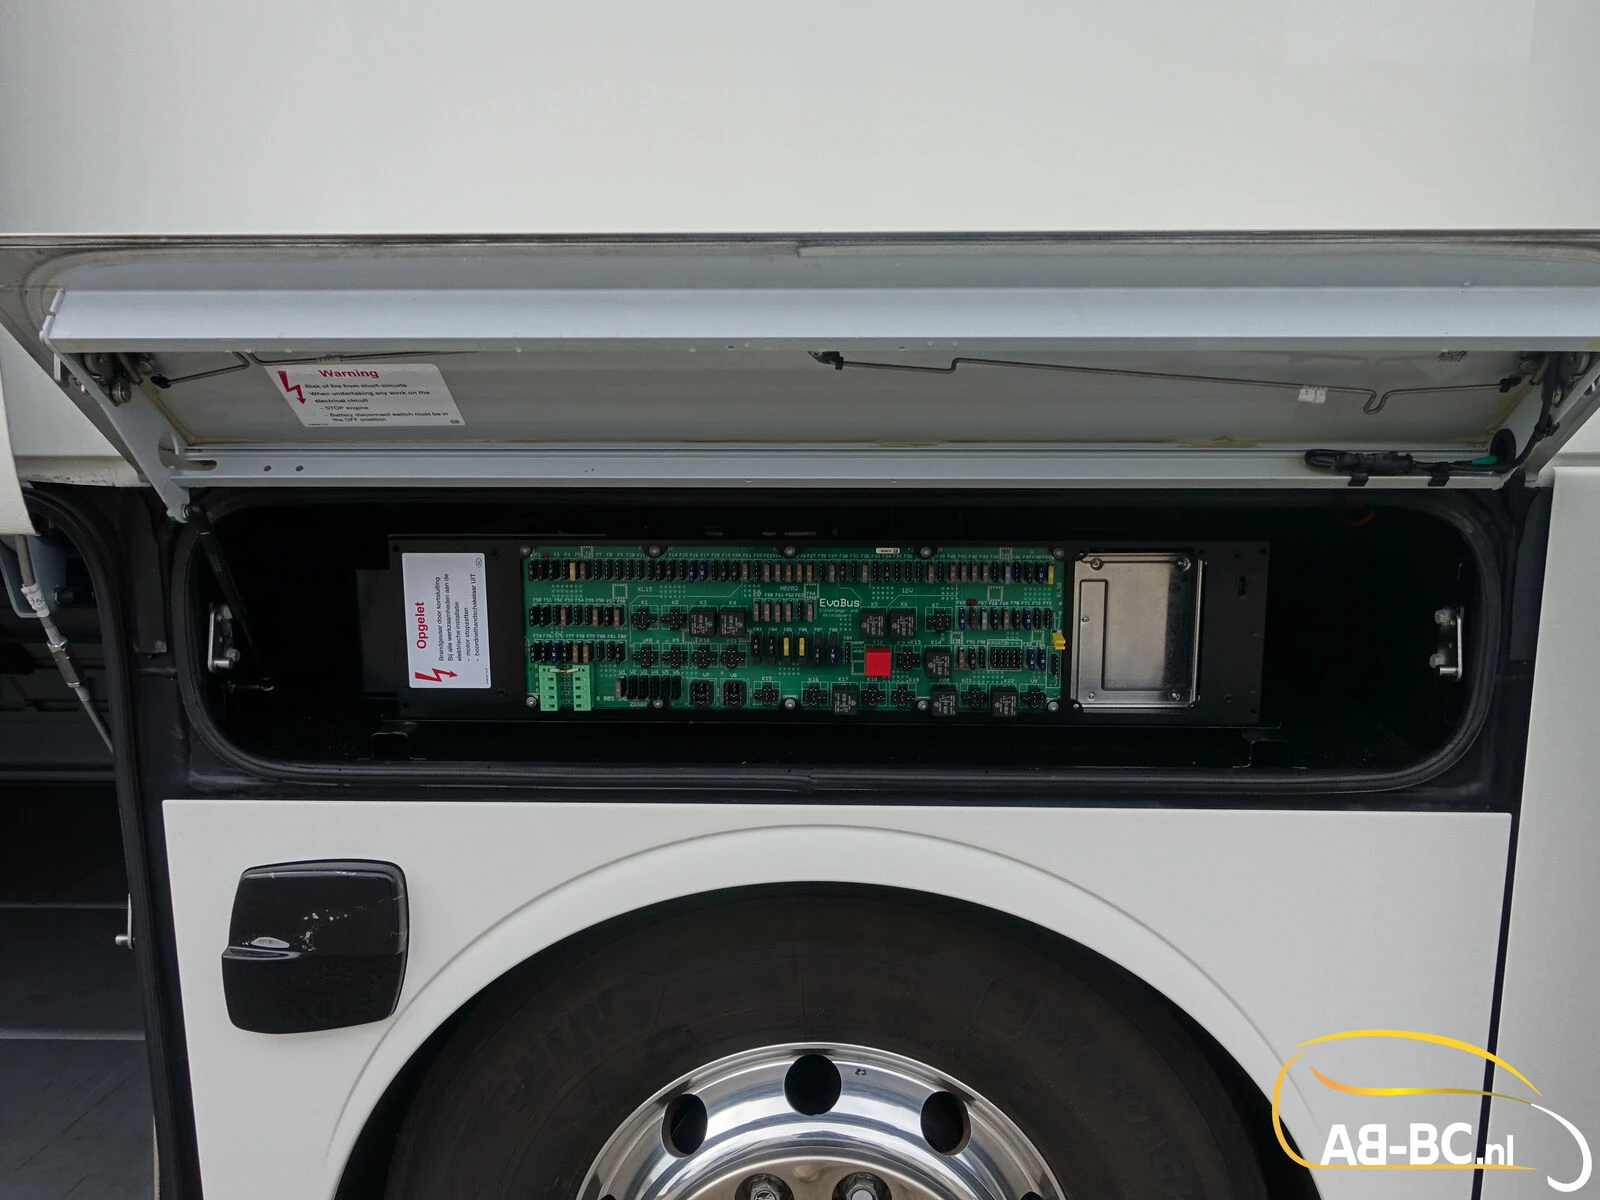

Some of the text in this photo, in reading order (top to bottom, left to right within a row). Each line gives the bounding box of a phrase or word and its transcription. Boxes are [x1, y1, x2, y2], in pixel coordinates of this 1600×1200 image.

[318, 369, 379, 379] Warning
[819, 598, 860, 607] EvoBus
[415, 602, 428, 649] Opgelet
